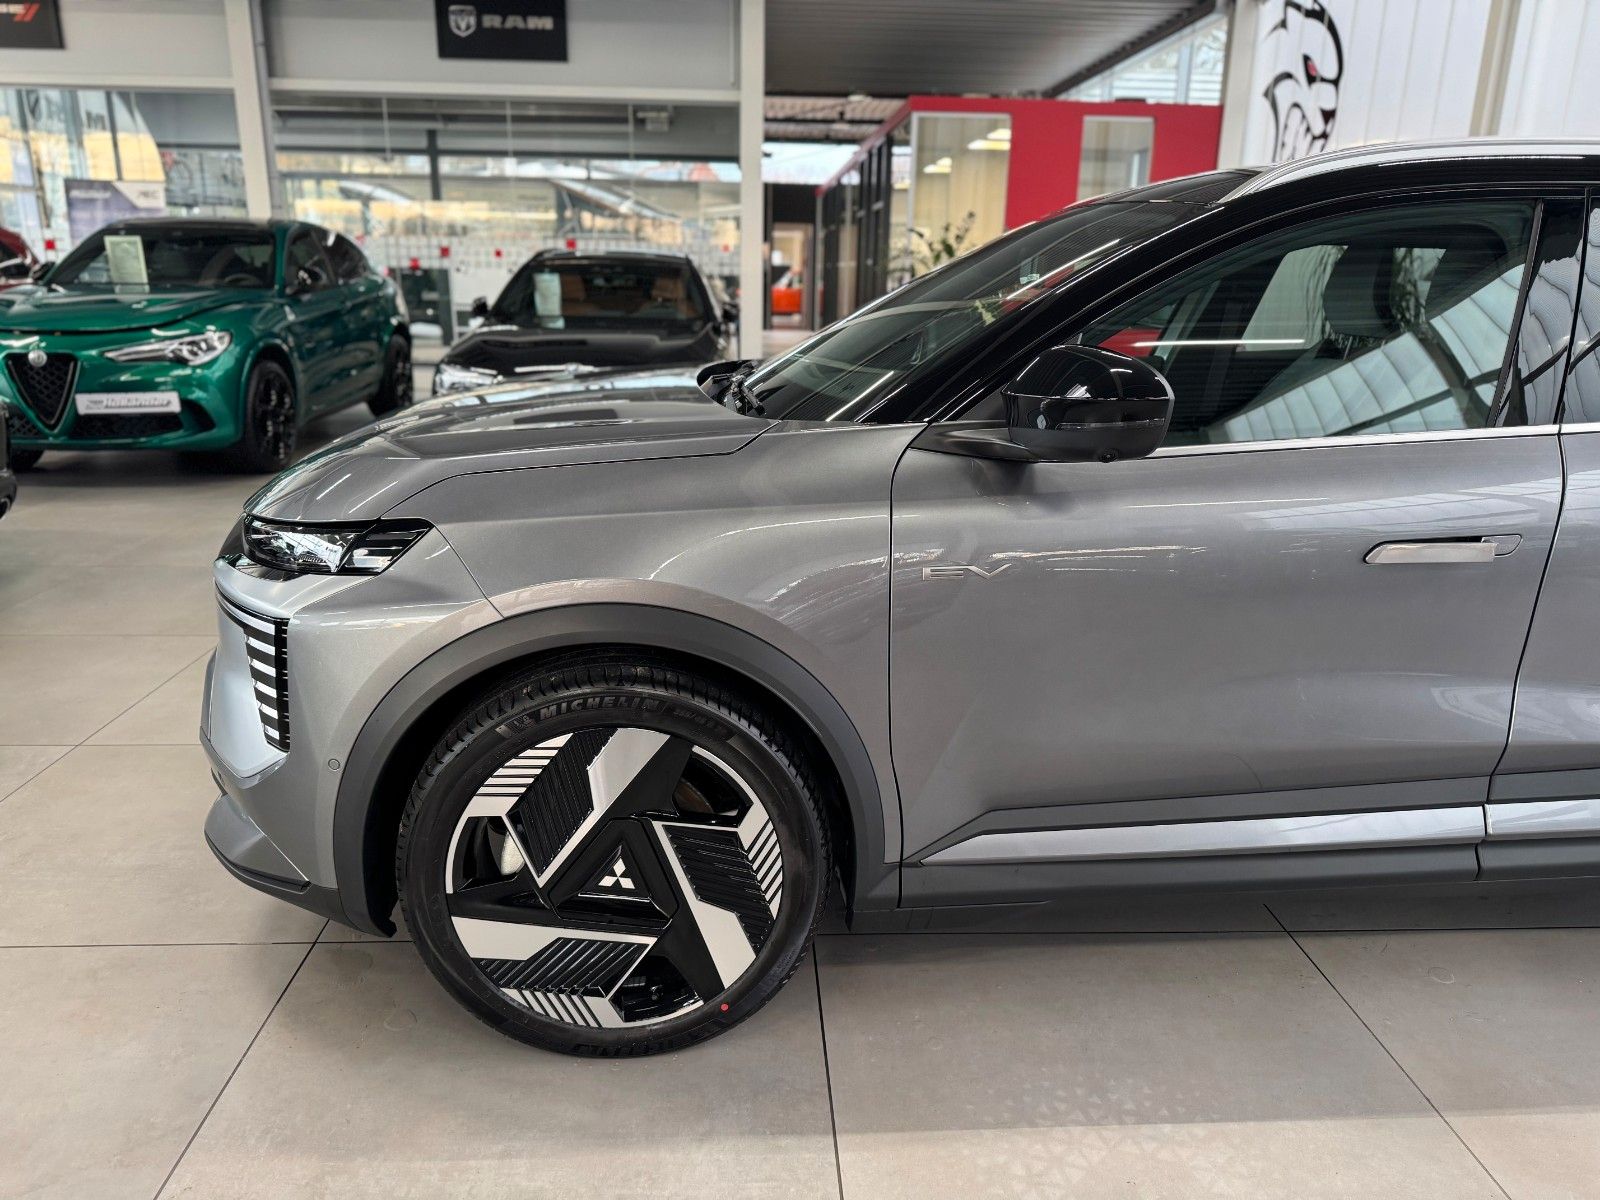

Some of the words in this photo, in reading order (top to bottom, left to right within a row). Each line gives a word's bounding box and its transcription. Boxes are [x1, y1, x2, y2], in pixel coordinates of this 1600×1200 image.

[481, 14, 554, 30] RAM
[922, 563, 1012, 580] EV
[540, 696, 661, 720] MICHELIN
